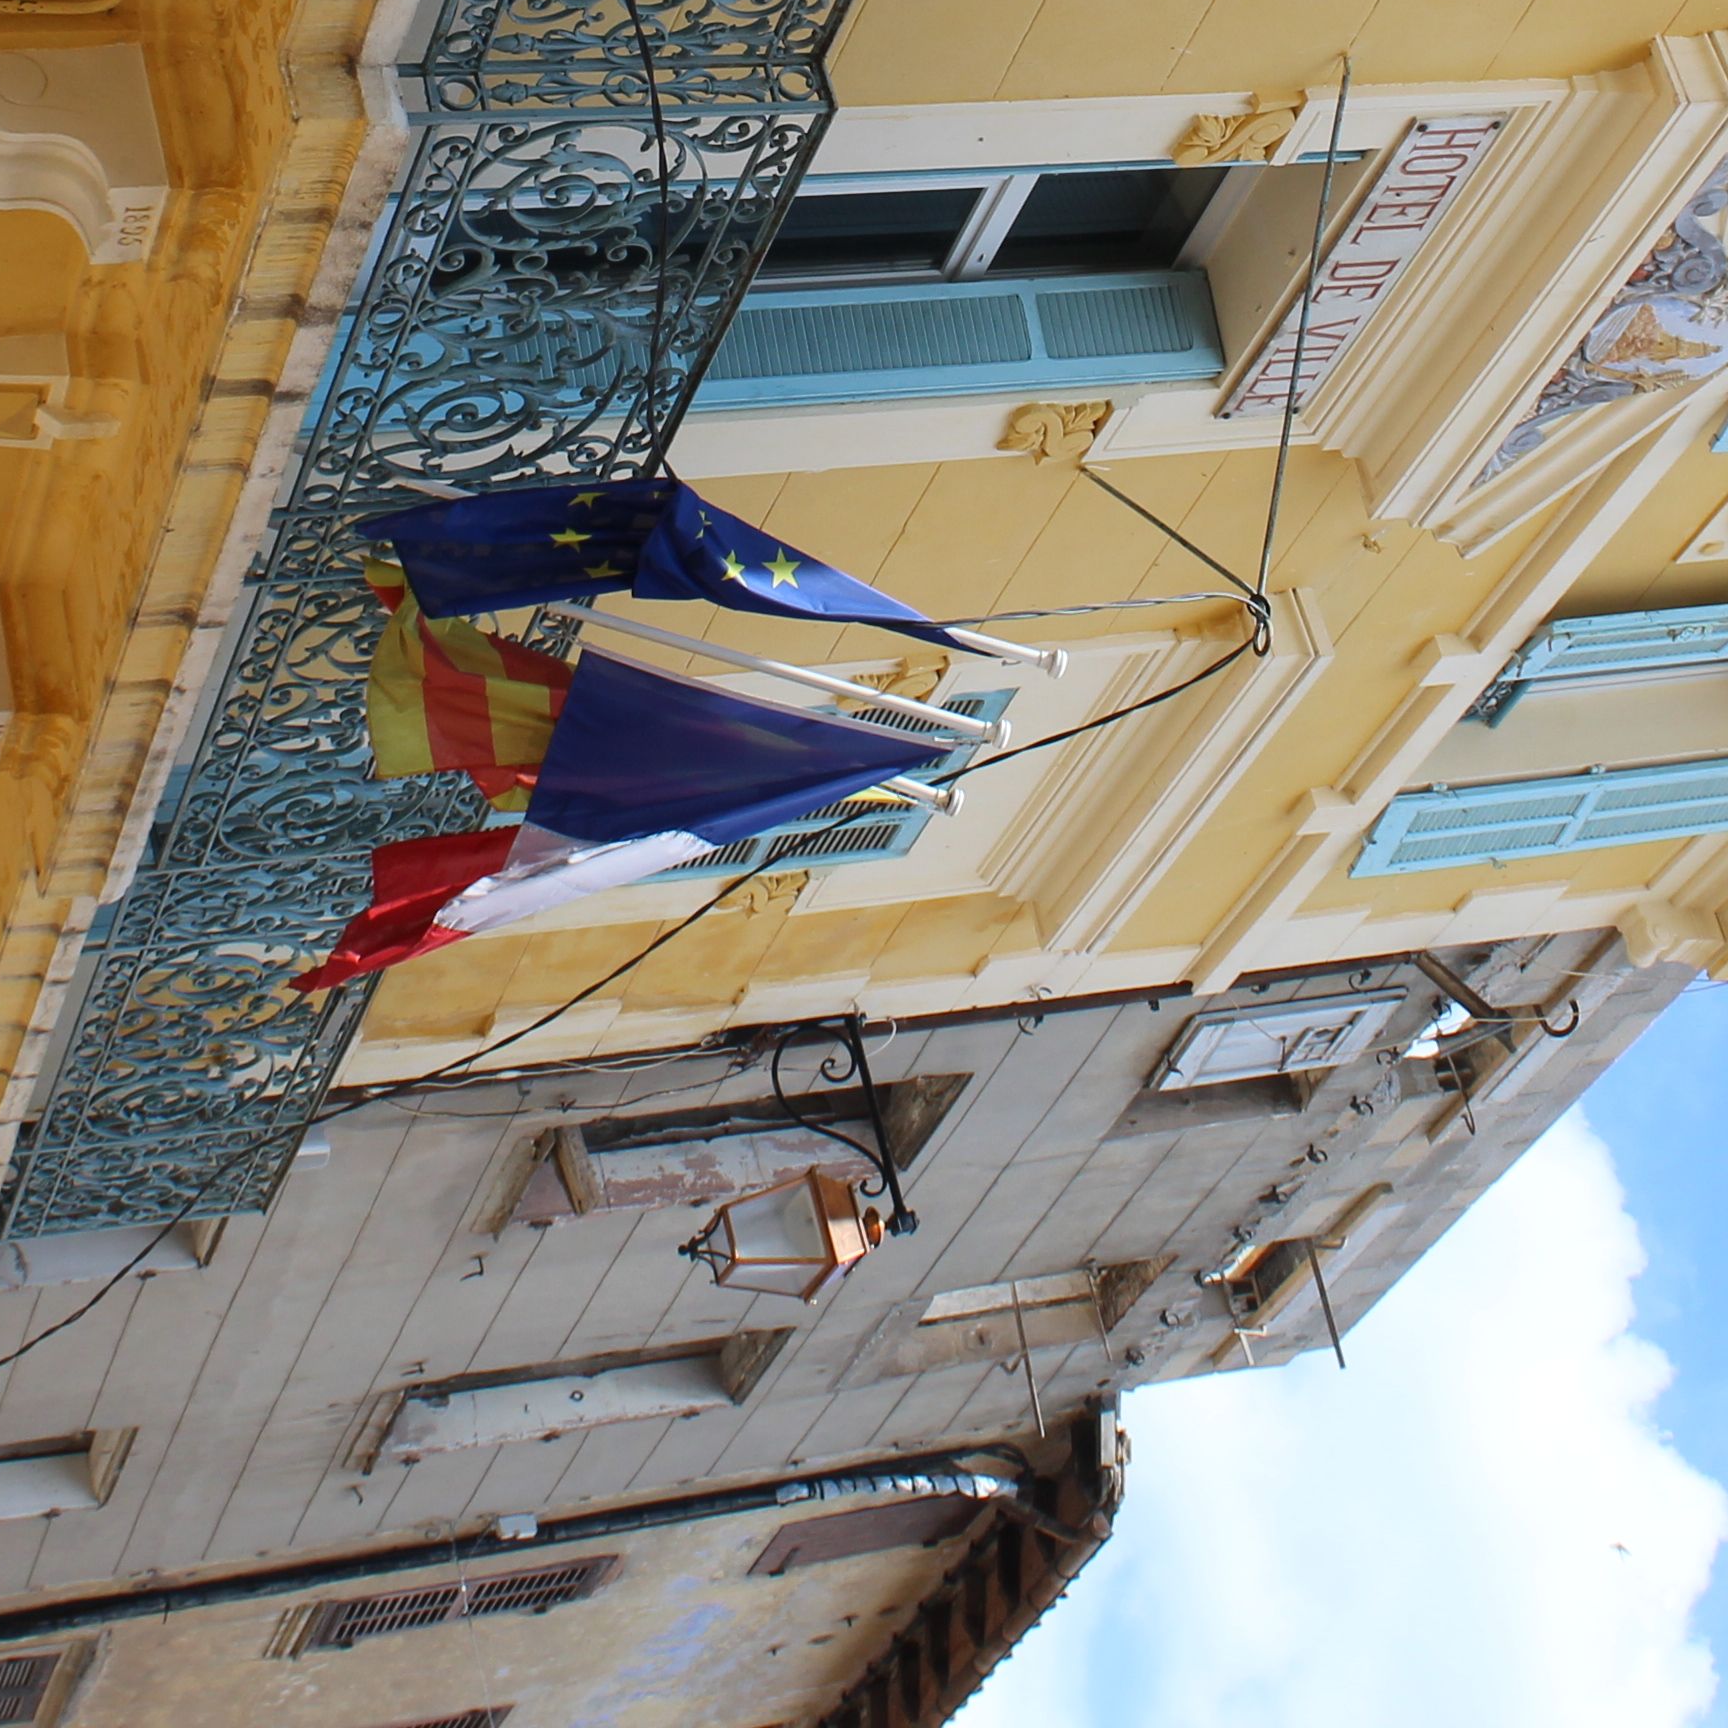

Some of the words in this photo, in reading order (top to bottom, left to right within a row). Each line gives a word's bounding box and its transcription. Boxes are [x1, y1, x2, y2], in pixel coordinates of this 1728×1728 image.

[1349, 123, 1495, 245] HOTEL
[1311, 257, 1402, 304] DE
[1234, 315, 1362, 412] VILLE
